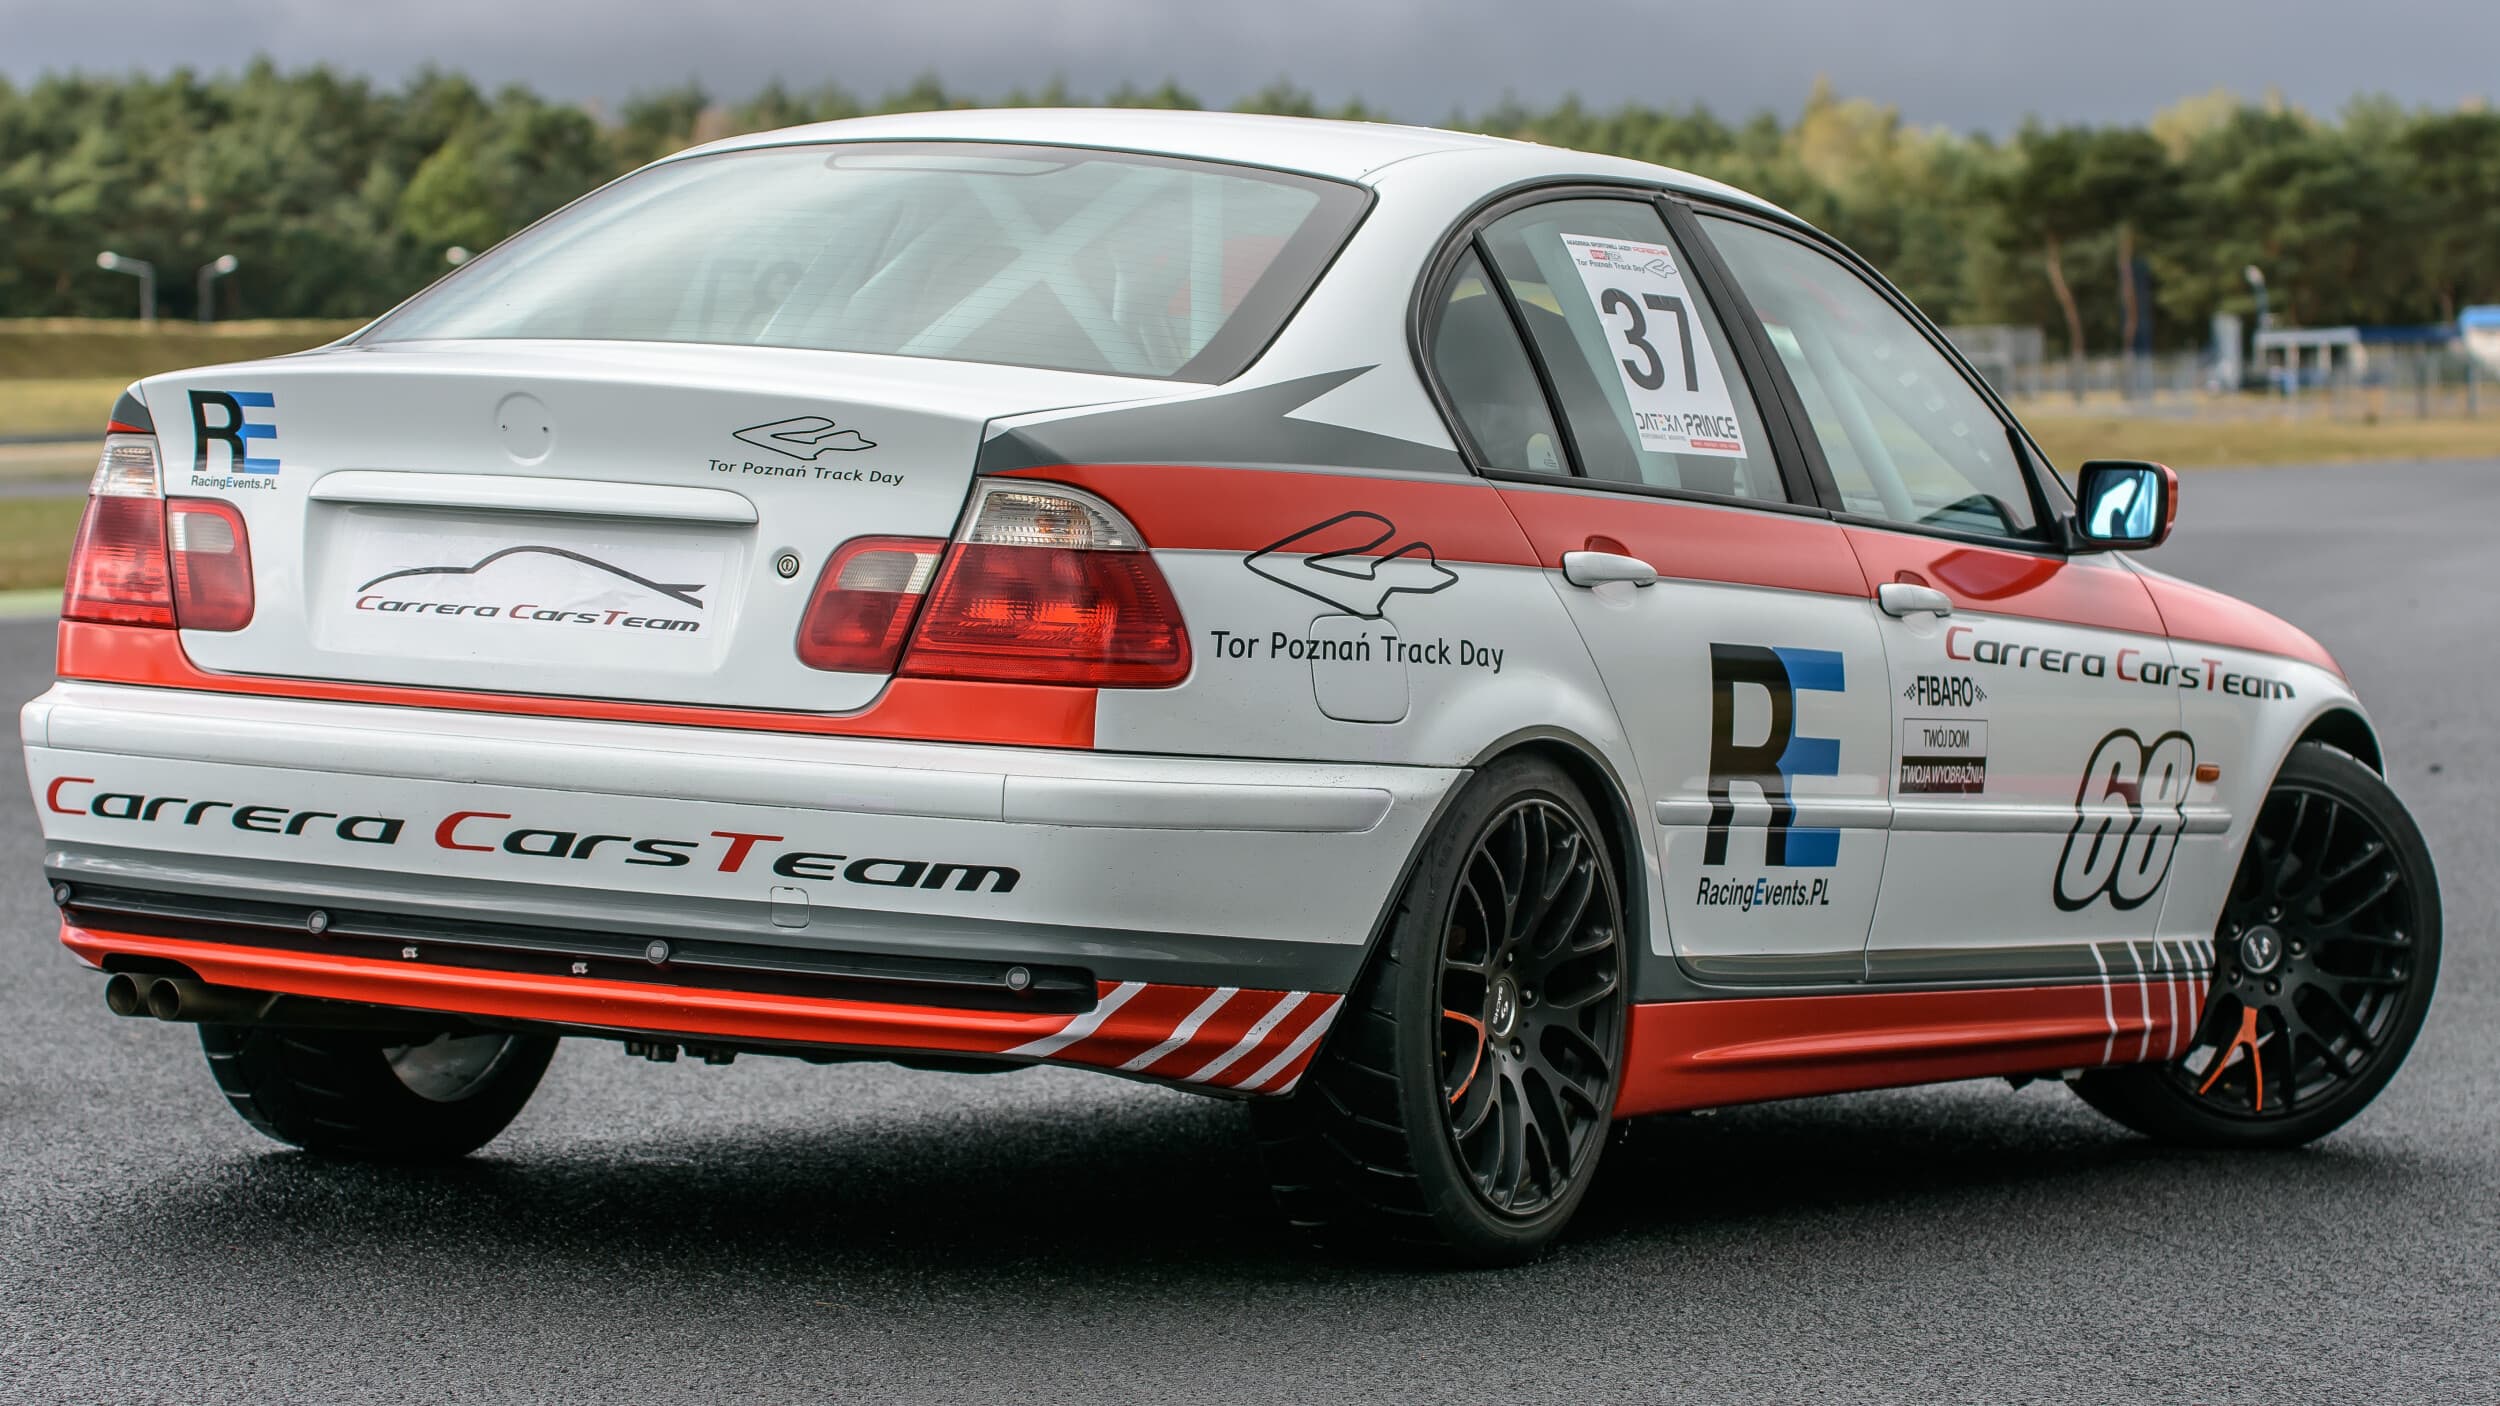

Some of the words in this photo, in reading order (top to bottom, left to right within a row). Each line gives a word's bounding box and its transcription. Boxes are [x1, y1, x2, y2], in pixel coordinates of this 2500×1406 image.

[1601, 288, 1698, 392] 37
[187, 389, 280, 475] RE
[1683, 413, 1738, 439] PRINCE
[191, 475, 278, 490] RacingEvents.PL
[708, 459, 737, 472] Tor
[742, 462, 806, 478] Poznań
[814, 467, 863, 482] Track
[869, 471, 904, 486] Day
[355, 595, 501, 618] Carrera
[1210, 631, 1260, 659] Tor
[1270, 632, 1371, 662] Poznań
[1380, 636, 1451, 666] Track
[1460, 640, 1504, 674] Day
[1945, 626, 2106, 678] Carrera
[1917, 675, 1974, 708] FIBARO
[1703, 642, 1845, 867] RE
[1923, 725, 1948, 749] TWÓJ
[1949, 729, 1970, 748] DOM
[1902, 764, 1931, 785] TWOJA
[1932, 761, 1984, 785] WYOBRAŹNIA
[46, 776, 405, 846] Carrera
[2053, 728, 2196, 912] 68
[1696, 876, 1830, 913] RacingEvents.PL
